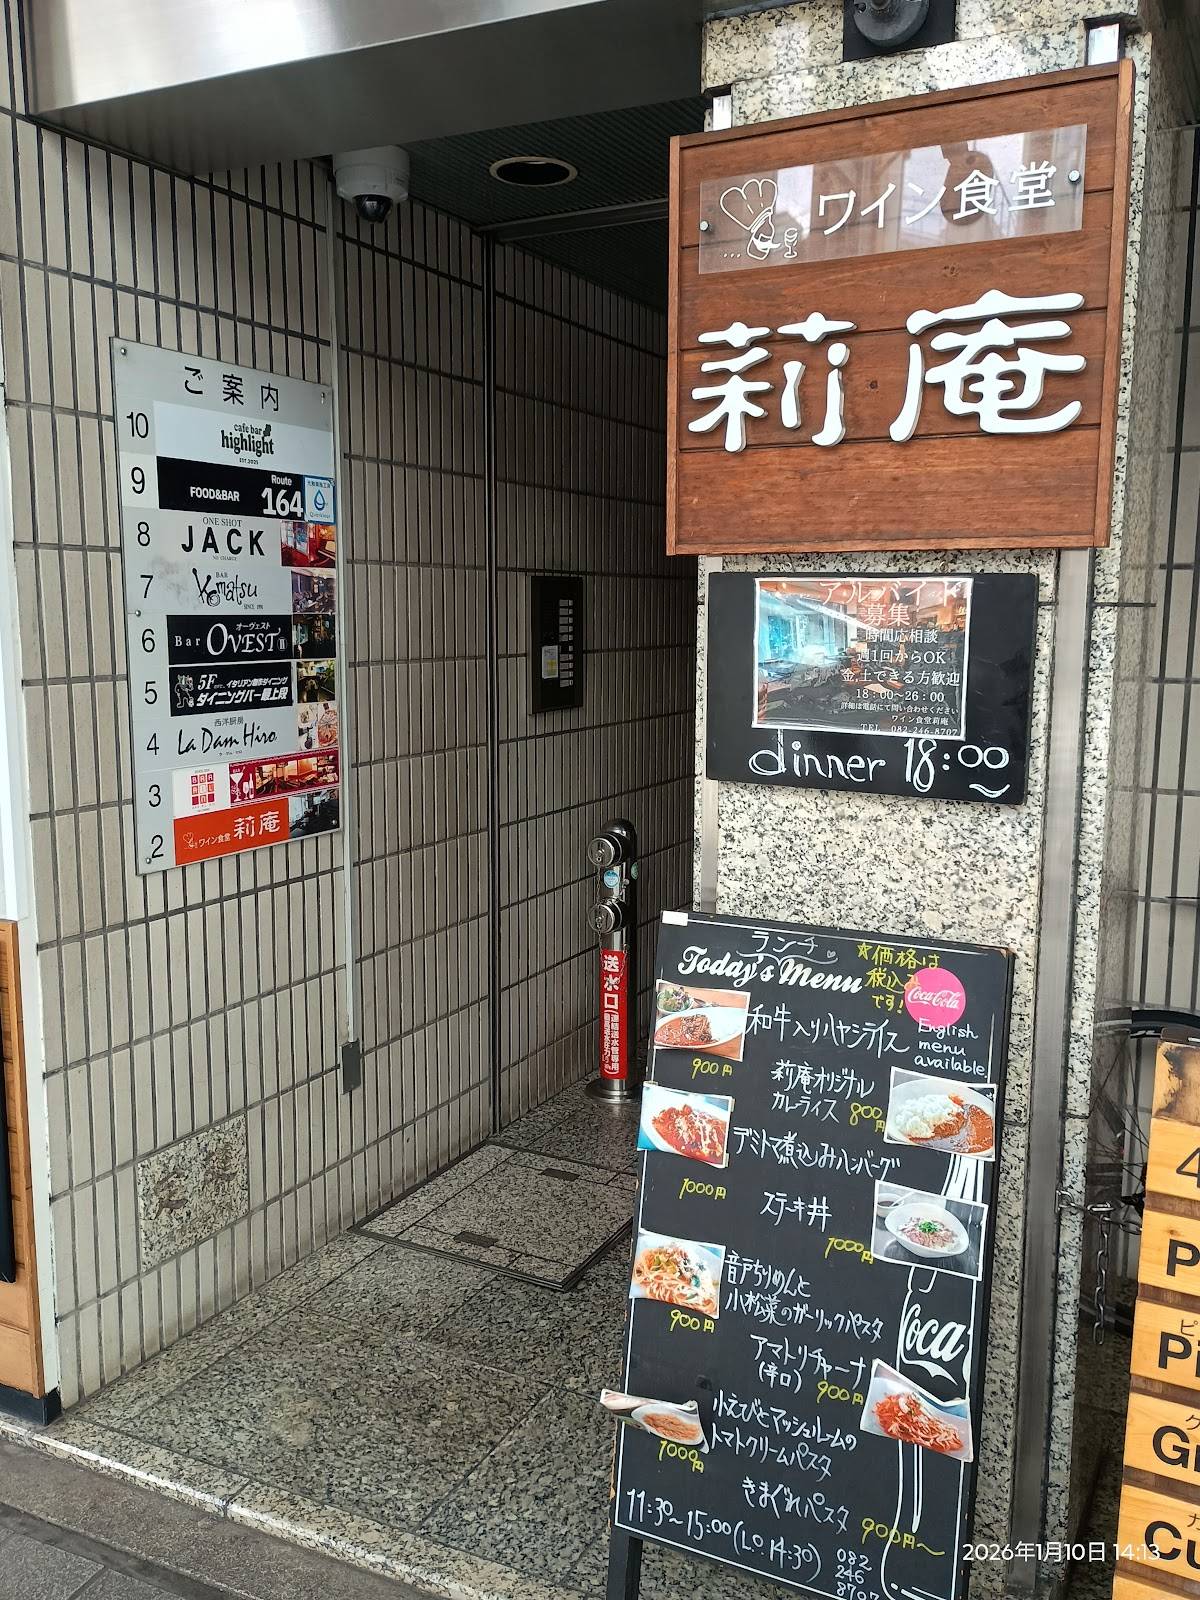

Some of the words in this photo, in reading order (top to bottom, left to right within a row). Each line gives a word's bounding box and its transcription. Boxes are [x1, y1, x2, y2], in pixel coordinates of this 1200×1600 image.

[817, 159, 1058, 237] ワイン食堂
[688, 289, 1086, 453] 莉庵
[184, 365, 280, 412] ご案内
[126, 411, 149, 438] 10
[234, 422, 249, 433] cafe
[250, 424, 262, 435] bar
[221, 430, 274, 457] highlight
[131, 466, 146, 494] 9
[271, 474, 292, 486] Route
[190, 486, 240, 502] FOOD&BAR
[261, 487, 304, 518] 164
[137, 521, 151, 547] 8
[202, 516, 220, 526] ONE
[221, 517, 243, 527] SHOT
[181, 525, 265, 556] JACK
[140, 574, 154, 599] 7
[863, 602, 911, 627] 募集
[141, 628, 156, 653] 6
[174, 635, 200, 647] Bar
[206, 623, 281, 655] OVEST
[865, 628, 939, 644] 時間応相談
[857, 649, 947, 665] 週1回からOK
[144, 680, 158, 705] 5
[196, 686, 289, 707] ダイニングバー最上段
[860, 723, 881, 733] TEL
[891, 725, 959, 736] 082-246-8707
[891, 715, 950, 726] ワイン食堂莉庵
[146, 733, 160, 756] 4
[177, 728, 197, 755] La
[201, 727, 239, 753] Dam
[243, 721, 277, 748] Hiro
[748, 729, 887, 783] dinner
[148, 784, 161, 807] 3
[233, 811, 281, 840] 莉庵
[151, 834, 164, 859] 2
[198, 832, 231, 847] ワイン食堂
[751, 930, 819, 955] ランチ
[603, 954, 620, 1010] 送水口
[677, 945, 775, 988] Today's
[777, 958, 862, 994] Menu
[744, 1002, 911, 1058] 和牛入りハヤシライス
[917, 1017, 979, 1040] English
[918, 1040, 967, 1057] menu
[691, 1057, 733, 1080] 900円
[770, 1058, 876, 1101] 莉庵オリジナル
[850, 1102, 887, 1132] 800円
[678, 1177, 727, 1201] 1000円
[823, 1237, 874, 1265] 1000円
[724, 1249, 812, 1299] 音戸ちりめんと
[669, 1308, 715, 1334] 900円
[724, 1287, 885, 1344] 小松菜のガーリックパスタ
[750, 1333, 867, 1391] アマトリチャーナ
[758, 1360, 802, 1395] (辛口)
[816, 1379, 864, 1406] 900円
[658, 1439, 705, 1474] 1000円
[711, 1422, 833, 1483] トマトクリームパスタ
[742, 1475, 850, 1536] きまぐれパスタ
[836, 1547, 873, 1573] 082
[834, 1564, 865, 1586] 246
